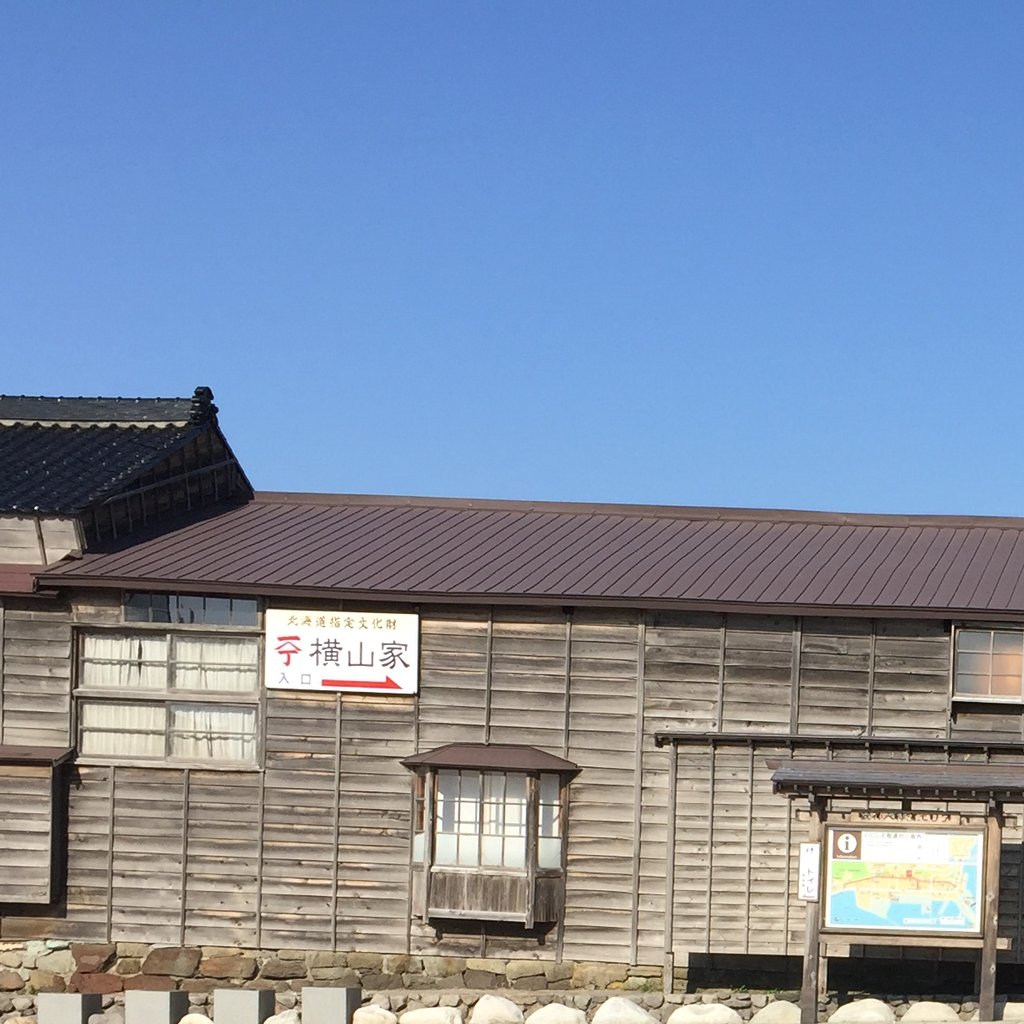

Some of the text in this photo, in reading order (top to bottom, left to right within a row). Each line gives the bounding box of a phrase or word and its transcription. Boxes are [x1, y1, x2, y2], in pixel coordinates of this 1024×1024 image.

[287, 614, 397, 631] 北海道指定文化財
[309, 637, 410, 670] 横山家
[278, 672, 311, 685] 入口
